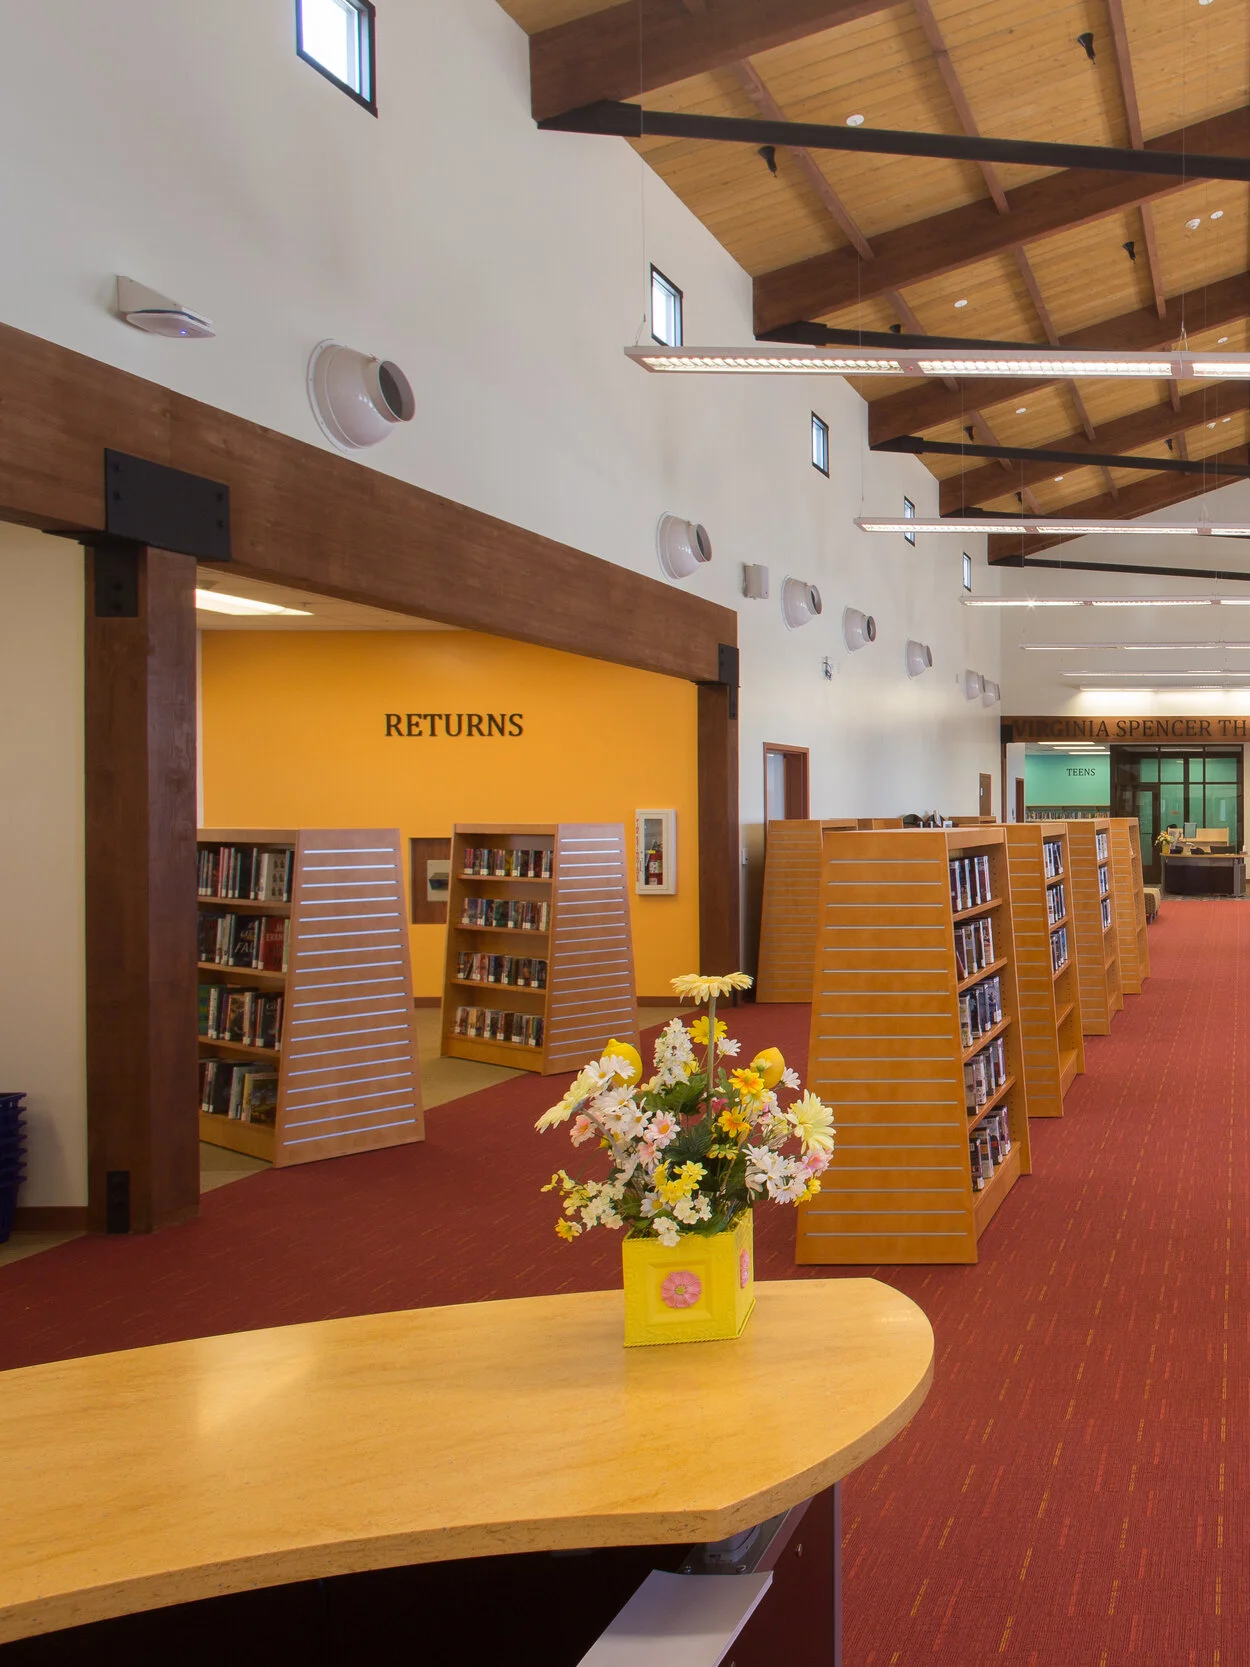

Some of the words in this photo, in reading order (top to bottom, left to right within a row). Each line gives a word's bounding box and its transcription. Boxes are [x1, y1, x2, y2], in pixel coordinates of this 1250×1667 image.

[385, 713, 524, 737] RETURNS
[1014, 720, 1109, 737] VIRGINIA
[1116, 719, 1211, 737] SPENCER
[1066, 768, 1096, 777] TEENS
